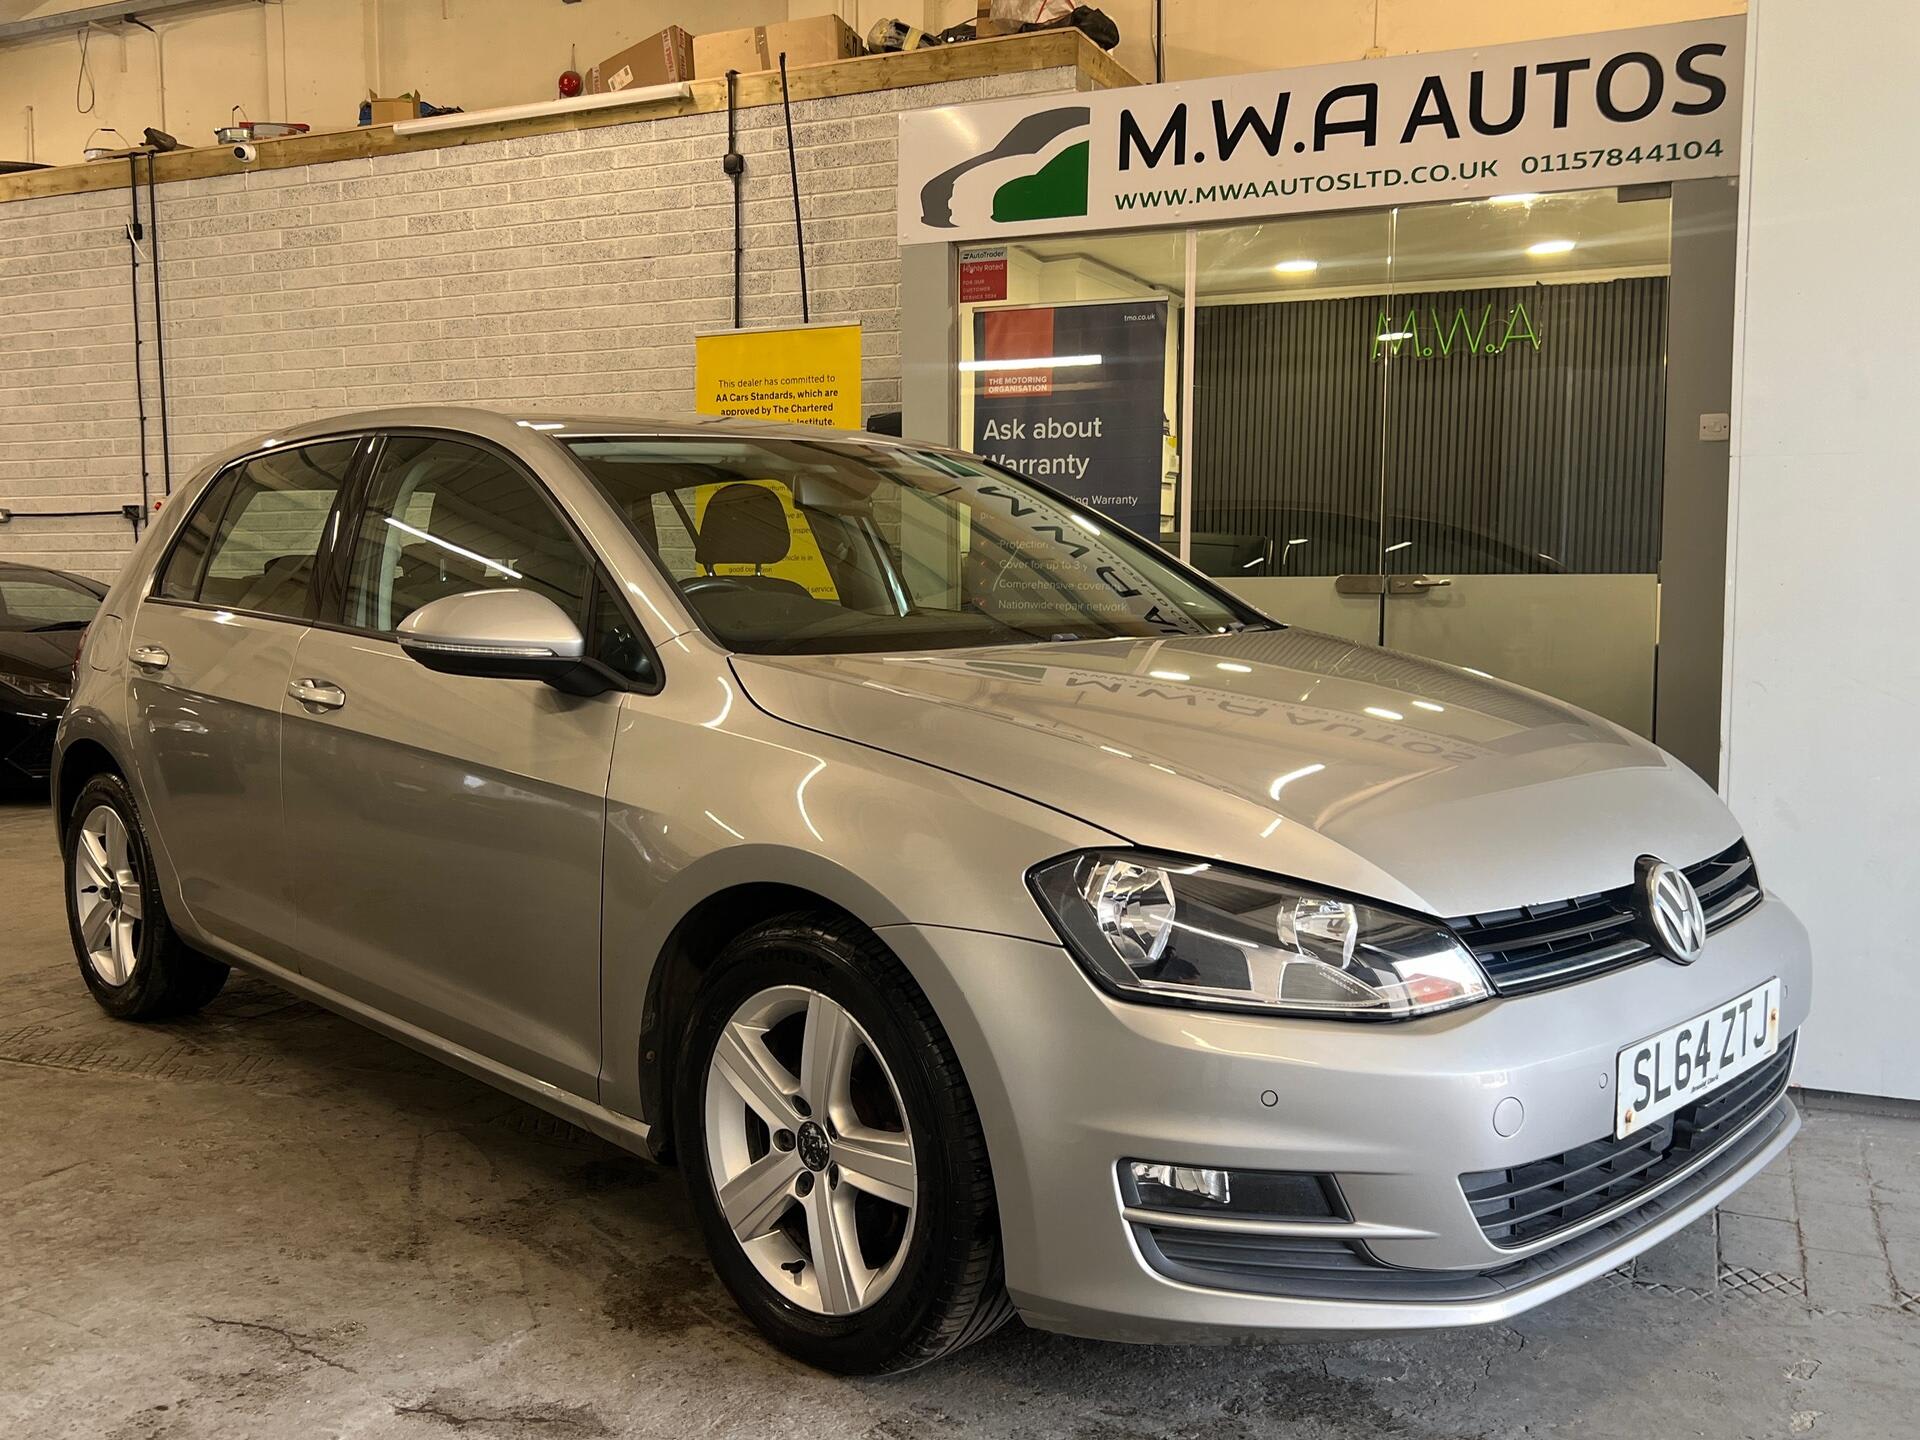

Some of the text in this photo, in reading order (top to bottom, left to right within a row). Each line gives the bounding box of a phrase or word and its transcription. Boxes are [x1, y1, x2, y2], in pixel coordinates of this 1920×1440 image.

[1118, 42, 1727, 172] M.W.A AUTOS
[1115, 138, 1724, 211] WWW.MWAAUTOSLTD.CO.UK 01157844104
[984, 262, 1004, 271] Rated
[1124, 313, 1156, 322] tmo.co.uk
[1372, 303, 1539, 360] M.W.A
[718, 374, 836, 389] This dealer has committed to
[988, 375, 1048, 386] THE MOTORING
[988, 384, 1048, 393] ORGANISATION
[715, 388, 839, 403] AA Cars Standards, which are
[720, 402, 834, 417] approved by The Chartered
[982, 416, 1103, 441] Ask about
[1091, 494, 1138, 507] Warranty
[728, 566, 745, 574] good
[999, 559, 1028, 570] Cover
[1030, 559, 1043, 570] for
[1046, 561, 1059, 572] up
[1060, 560, 1072, 570] to
[999, 579, 1074, 591] Comprehensive
[998, 599, 1128, 611] Nationwide repair network
[1632, 989, 1769, 1113] SL64 ZTJ
